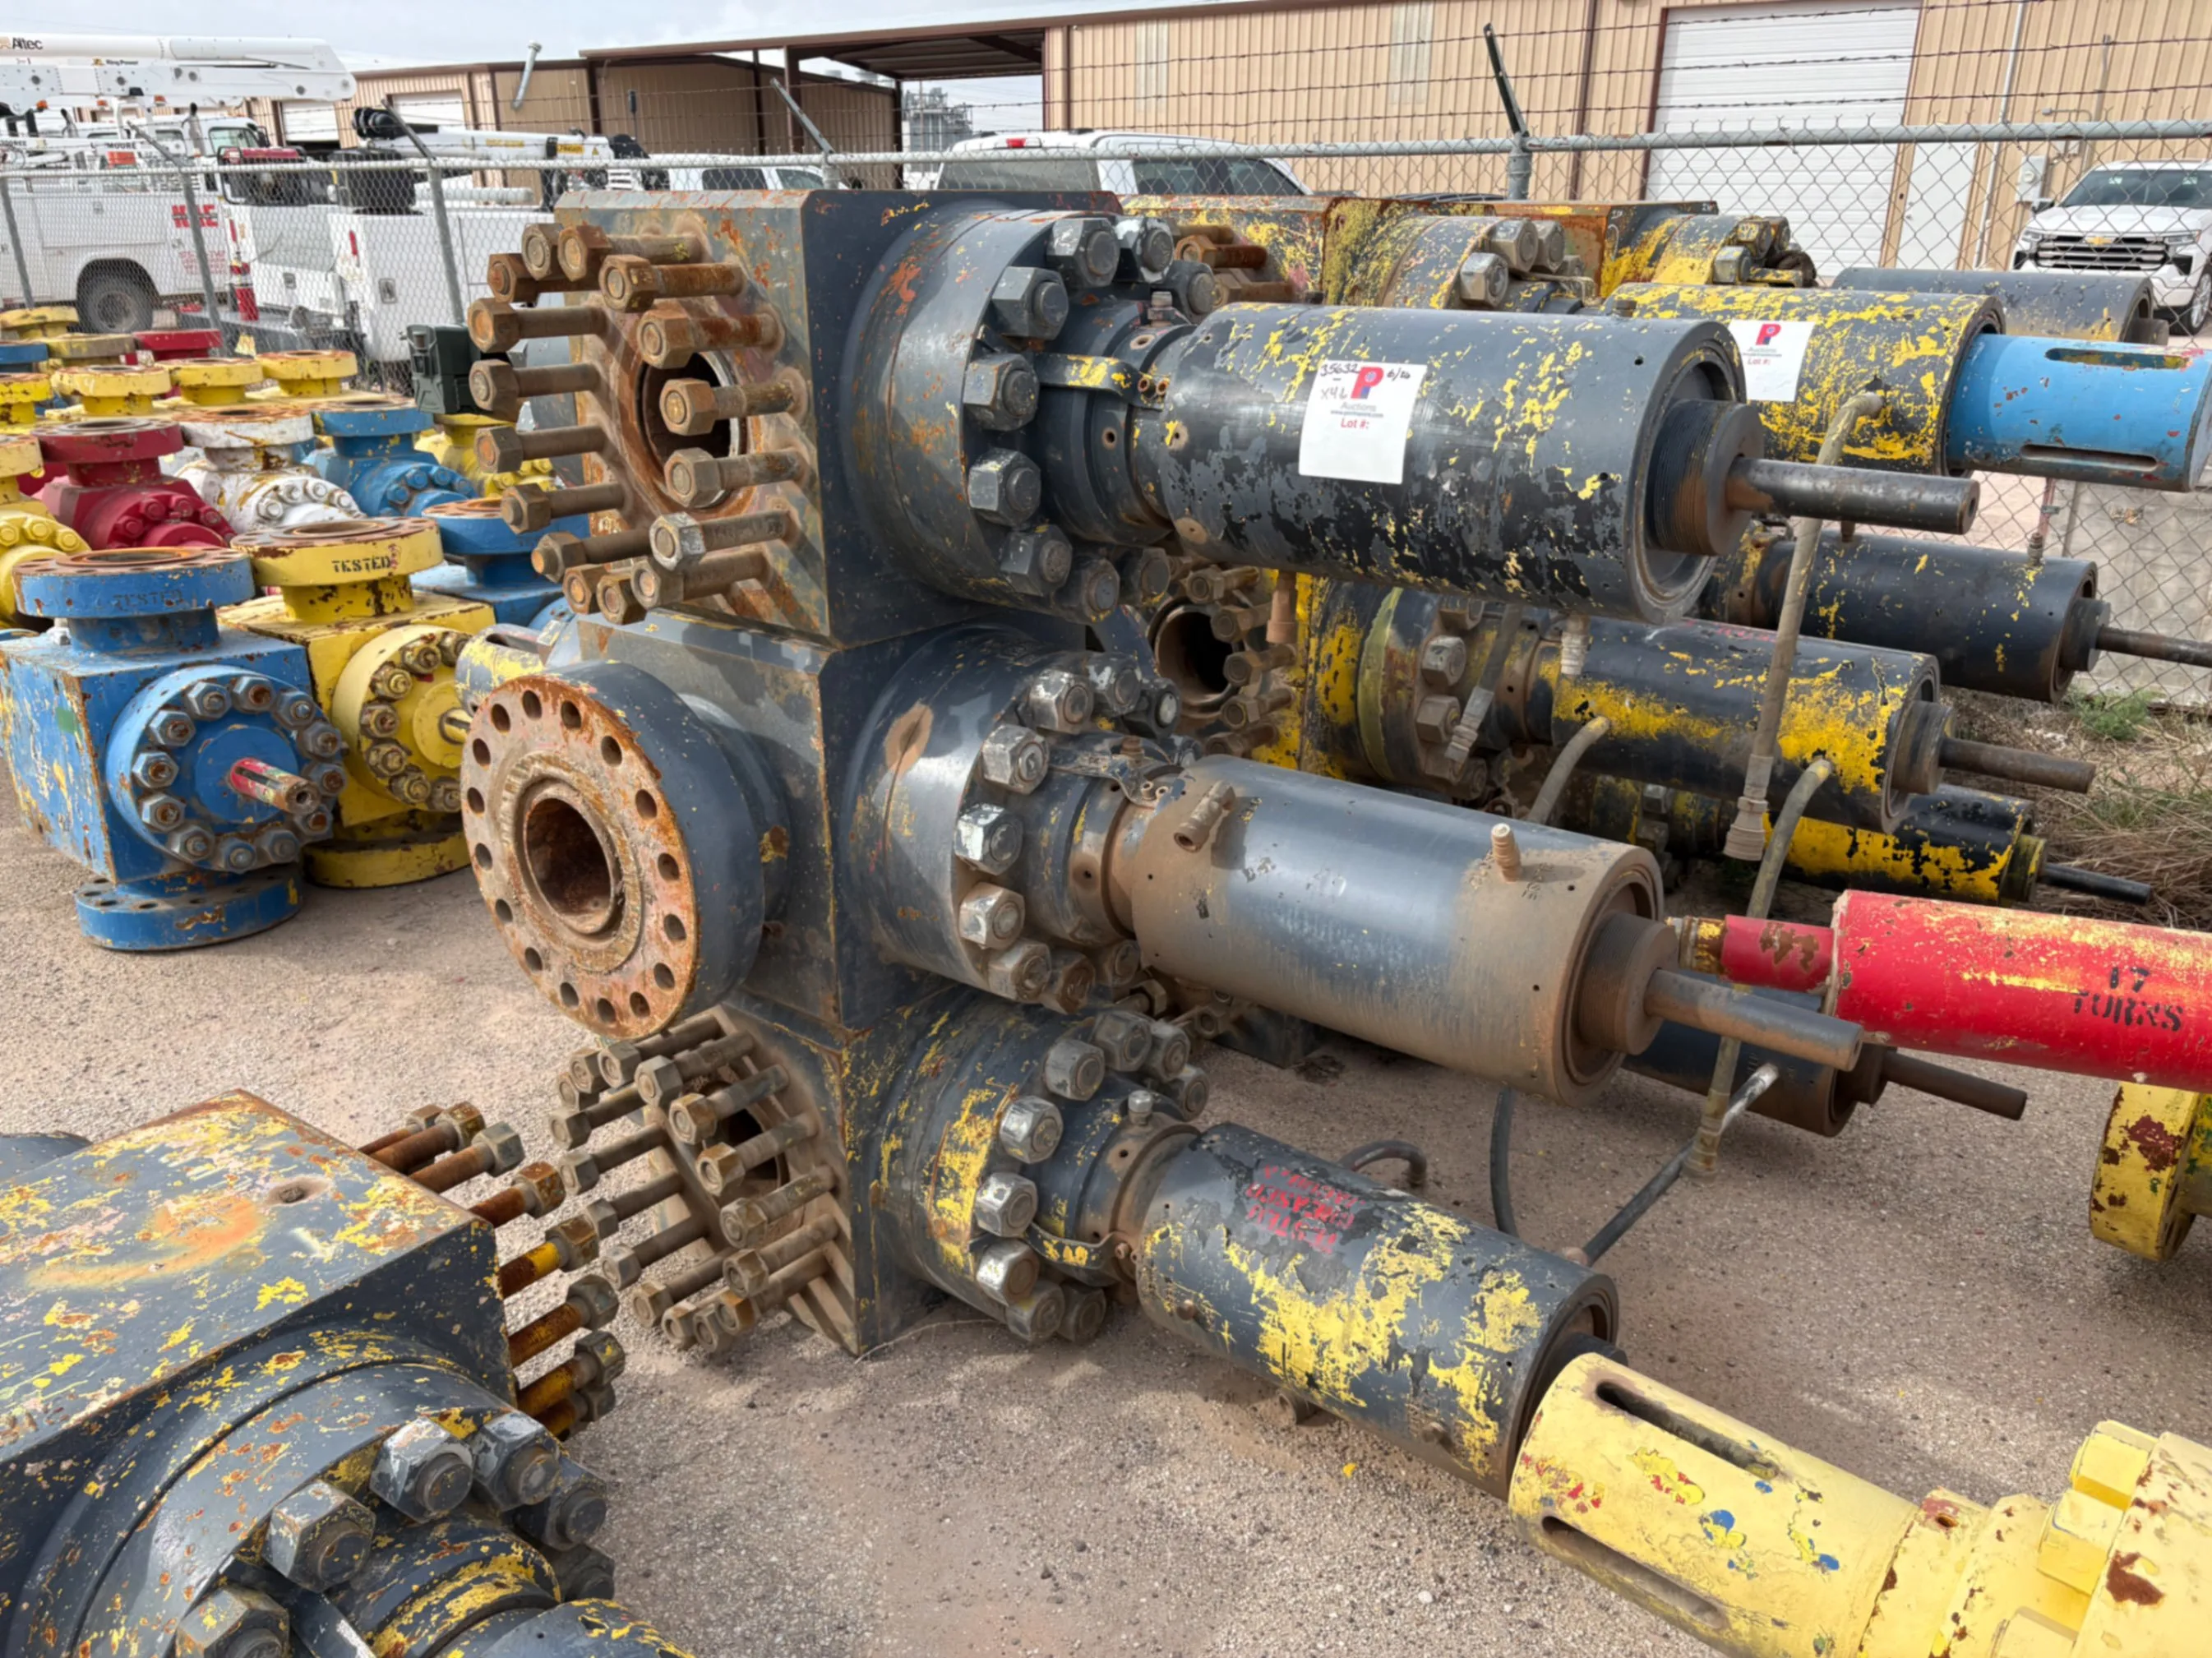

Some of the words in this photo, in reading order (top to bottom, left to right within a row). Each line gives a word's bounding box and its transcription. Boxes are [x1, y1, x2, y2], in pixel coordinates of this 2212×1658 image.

[12, 37, 43, 50] Altec
[1340, 401, 1377, 412] Auctions
[1341, 418, 1357, 428] Lot
[331, 556, 392, 573] TESTED
[2109, 966, 2150, 992] 17
